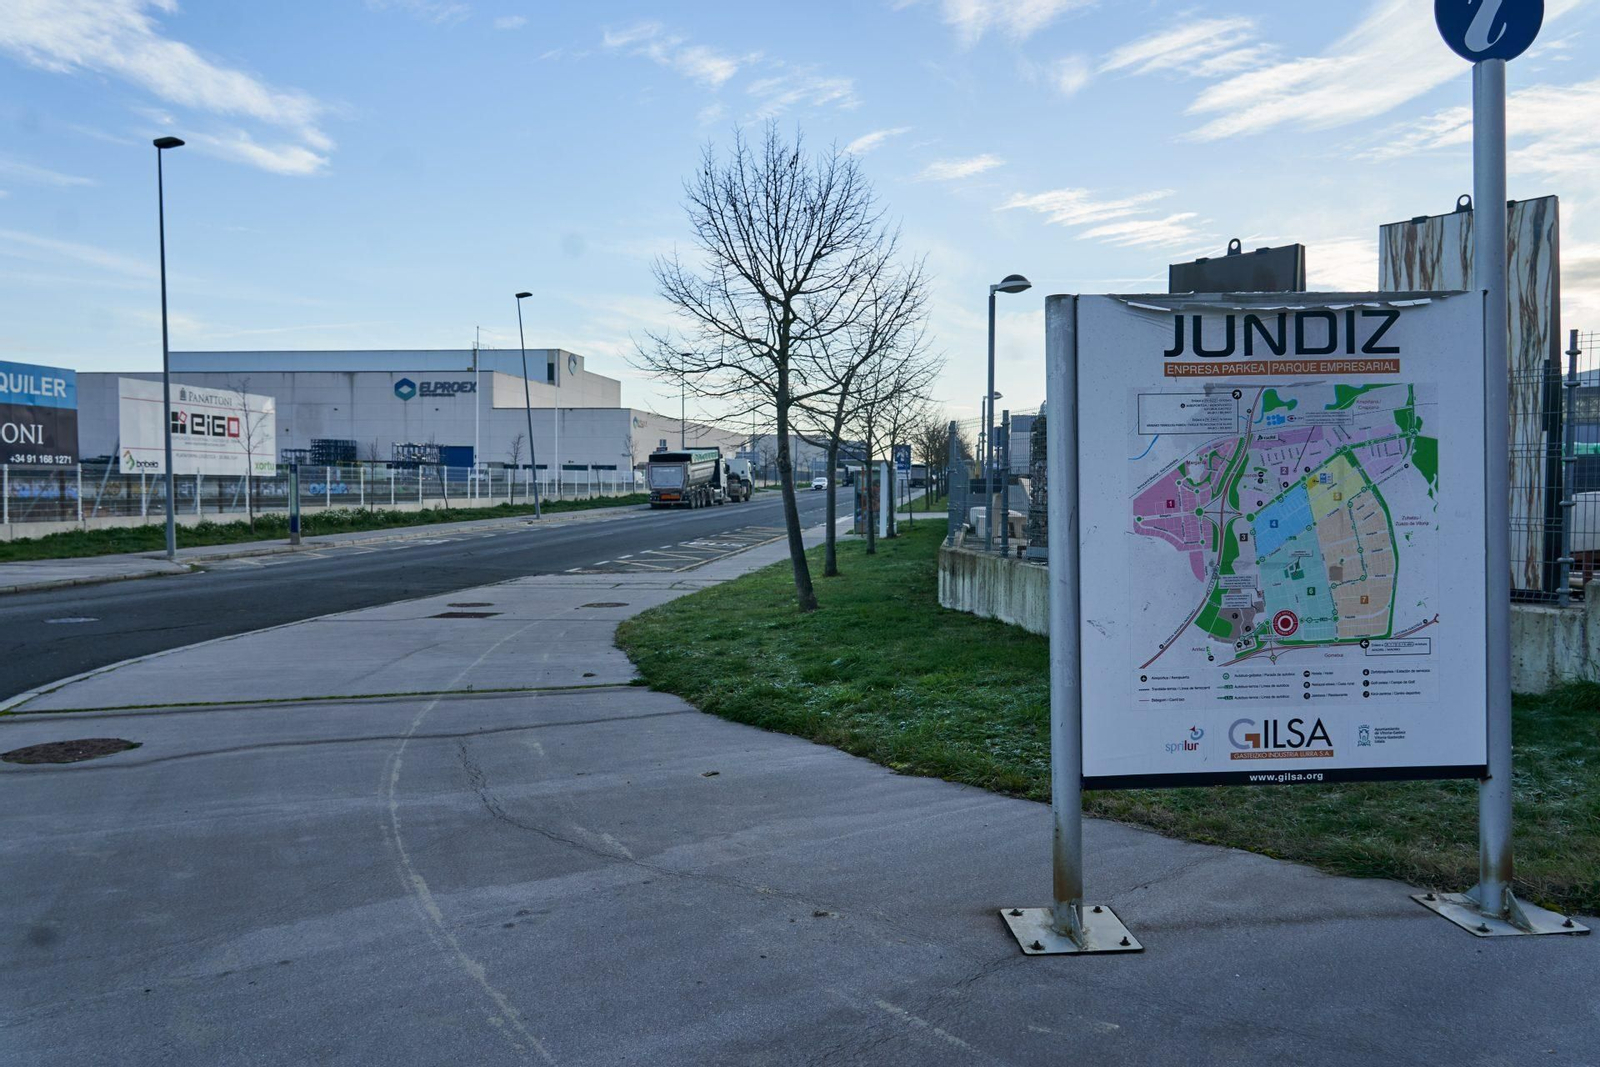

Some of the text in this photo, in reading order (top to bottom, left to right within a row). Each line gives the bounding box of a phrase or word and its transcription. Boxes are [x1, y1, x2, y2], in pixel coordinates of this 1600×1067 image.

[1164, 309, 1401, 358] JUNDIZ
[1166, 359, 1397, 374] ENPRESA PARKEA PARQUE EMPRESARIAL
[419, 381, 477, 393] ELPROEX
[188, 390, 233, 406] PANATTONI
[26, 454, 37, 463] 91
[39, 455, 53, 464] 168
[54, 455, 72, 464] 1271
[1228, 717, 1333, 750] GILSA
[1165, 739, 1200, 754] sprilur
[1249, 772, 1324, 782] www.gilsa.org
